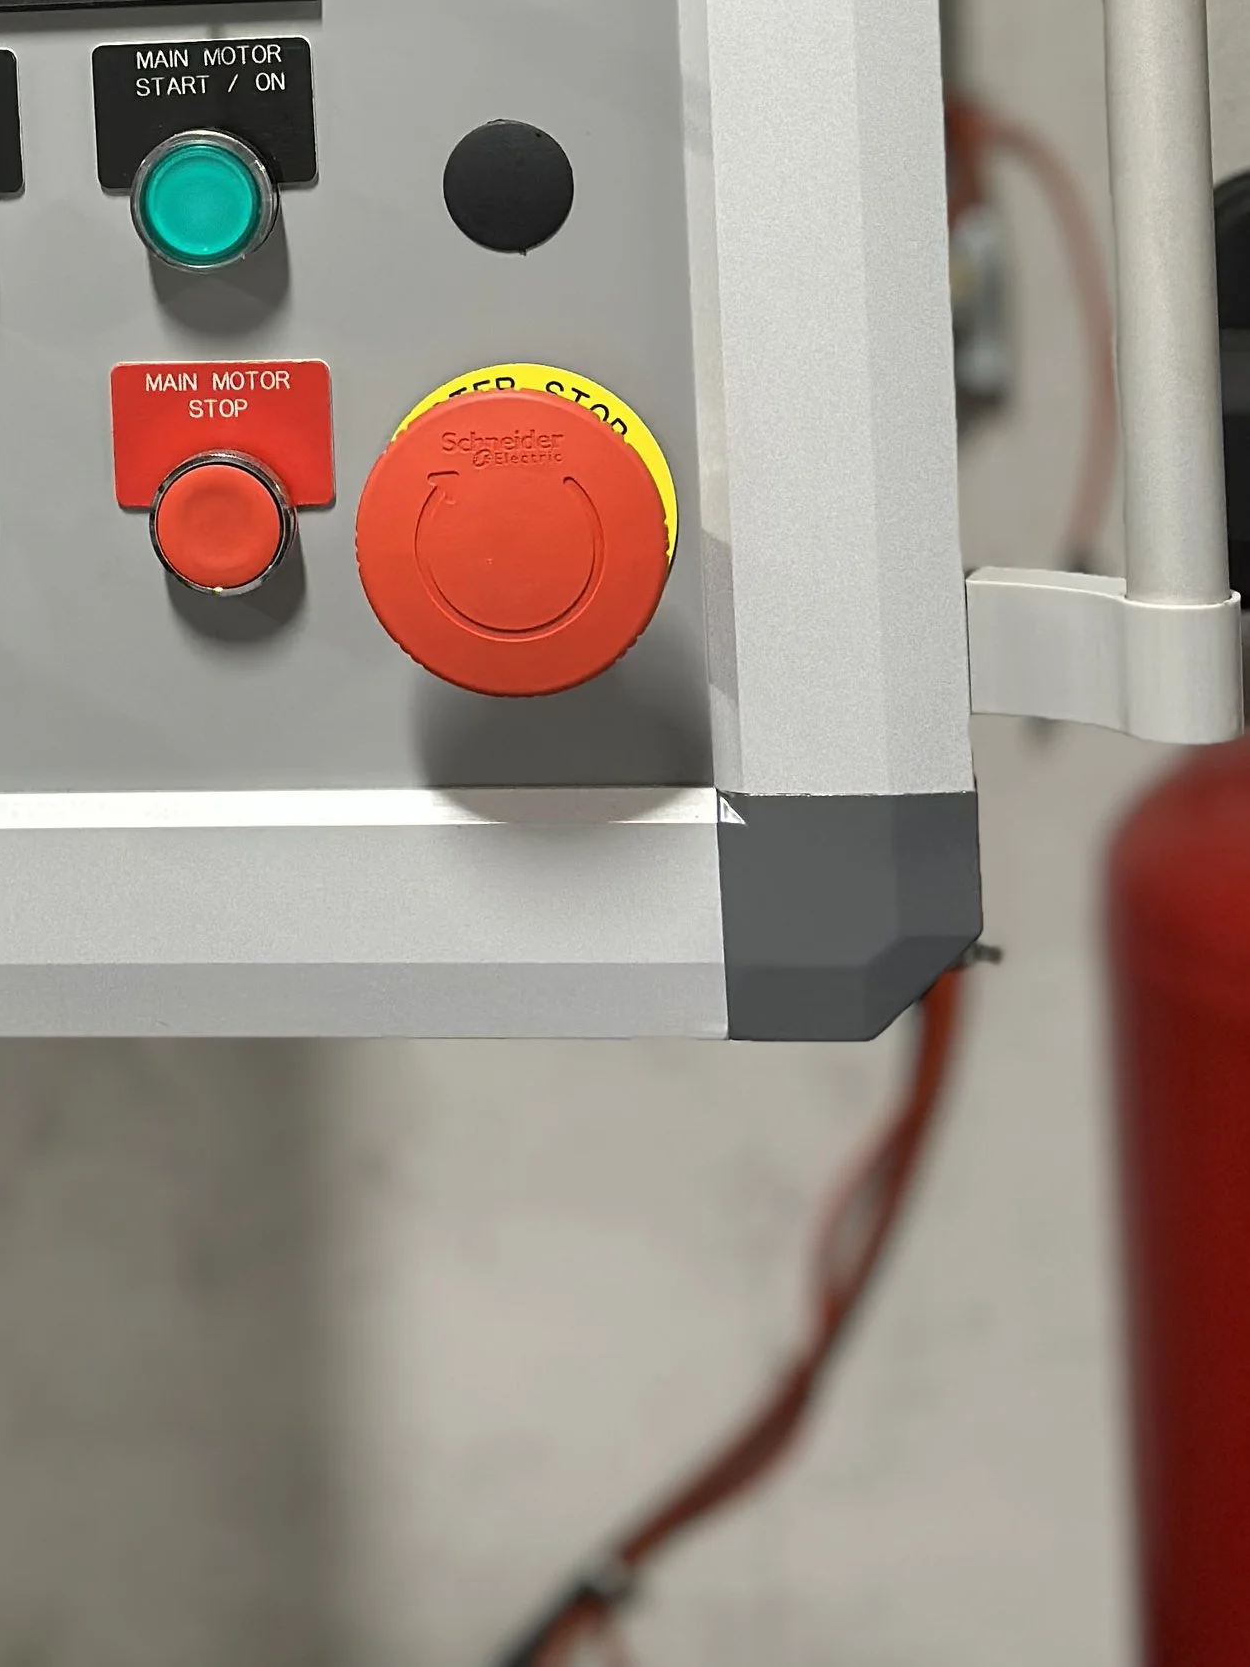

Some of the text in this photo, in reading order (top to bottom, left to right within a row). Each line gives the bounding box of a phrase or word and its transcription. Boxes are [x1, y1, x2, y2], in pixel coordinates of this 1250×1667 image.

[136, 44, 282, 70] MAIN MOTOR
[136, 72, 286, 97] START / ON
[145, 370, 291, 391] MAIN MOTOR
[189, 398, 249, 418] STOP
[441, 429, 565, 452] Schneider
[494, 451, 563, 465] Electric
